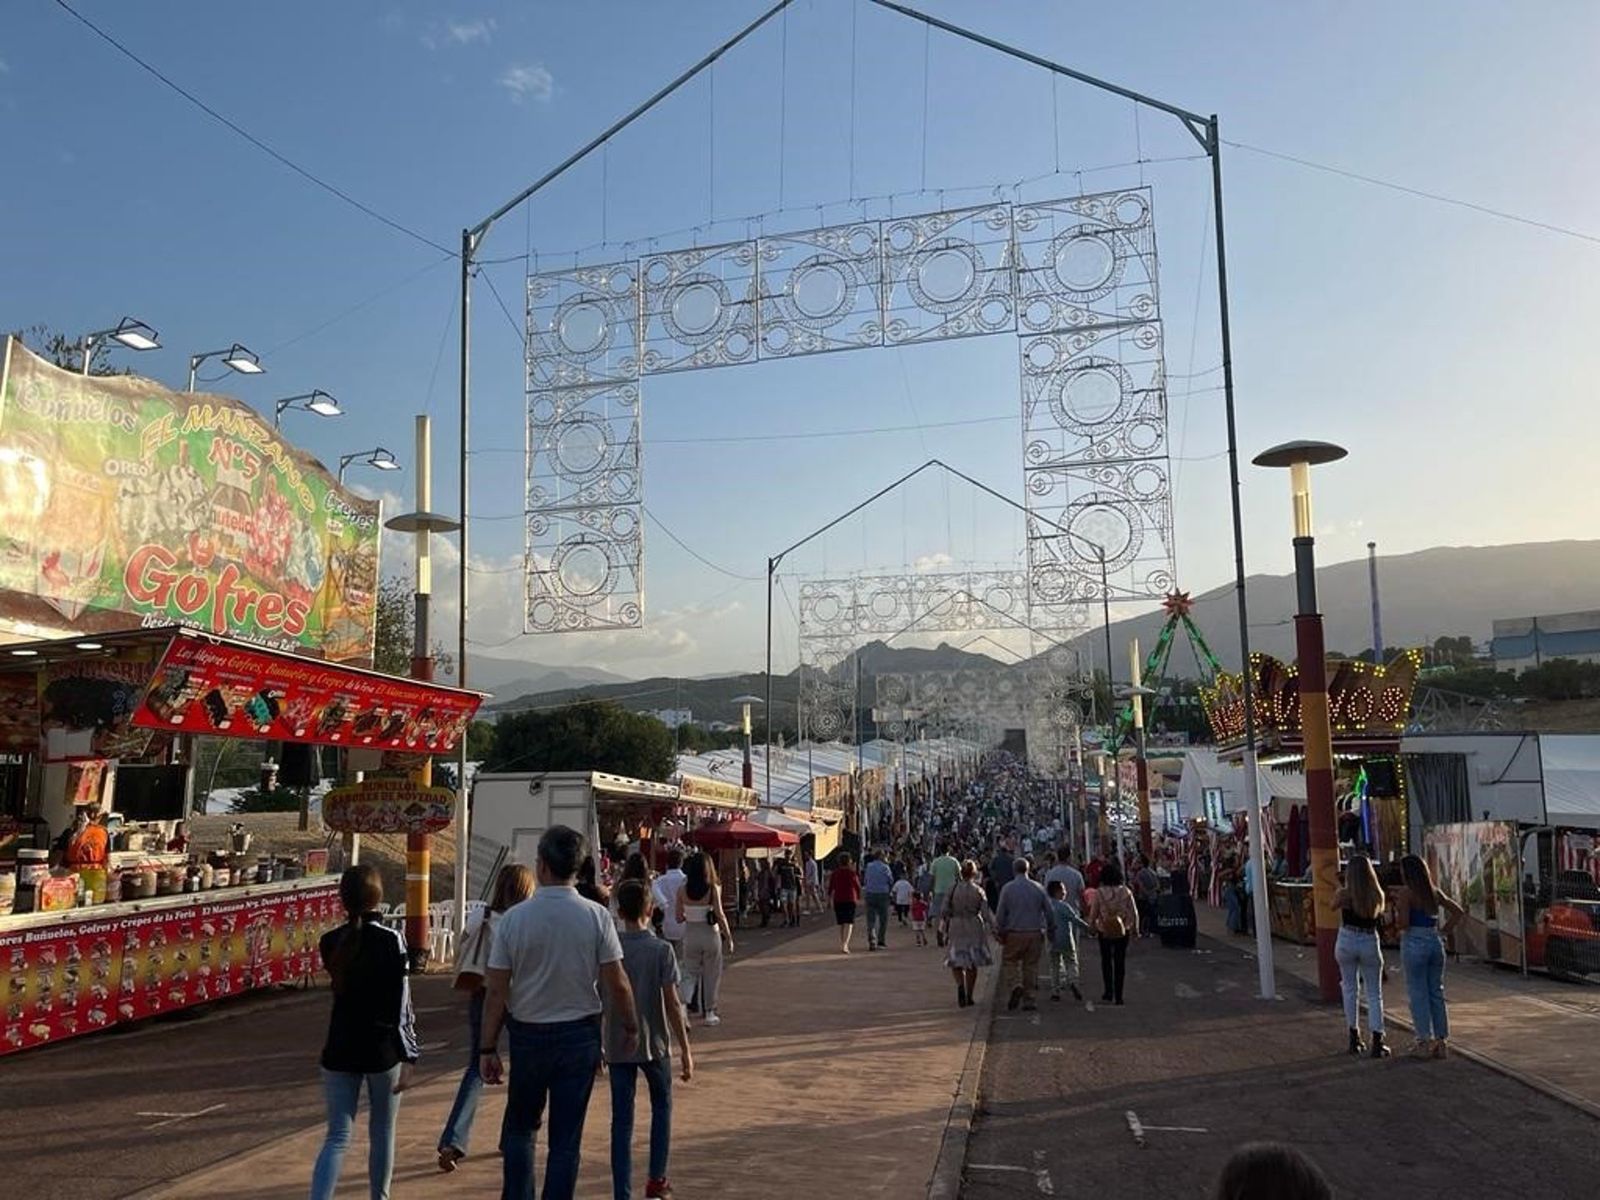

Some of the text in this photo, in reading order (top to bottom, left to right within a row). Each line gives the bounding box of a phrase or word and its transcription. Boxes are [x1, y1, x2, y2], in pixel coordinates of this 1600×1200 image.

[140, 404, 316, 513] EL MANZANO
[324, 490, 374, 528] Crepes
[123, 544, 311, 636] Gofres
[79, 922, 110, 935] Gofres
[111, 922, 119, 932] y
[120, 916, 152, 929] Crepes
[153, 914, 165, 922] de
[174, 909, 196, 920] Feria
